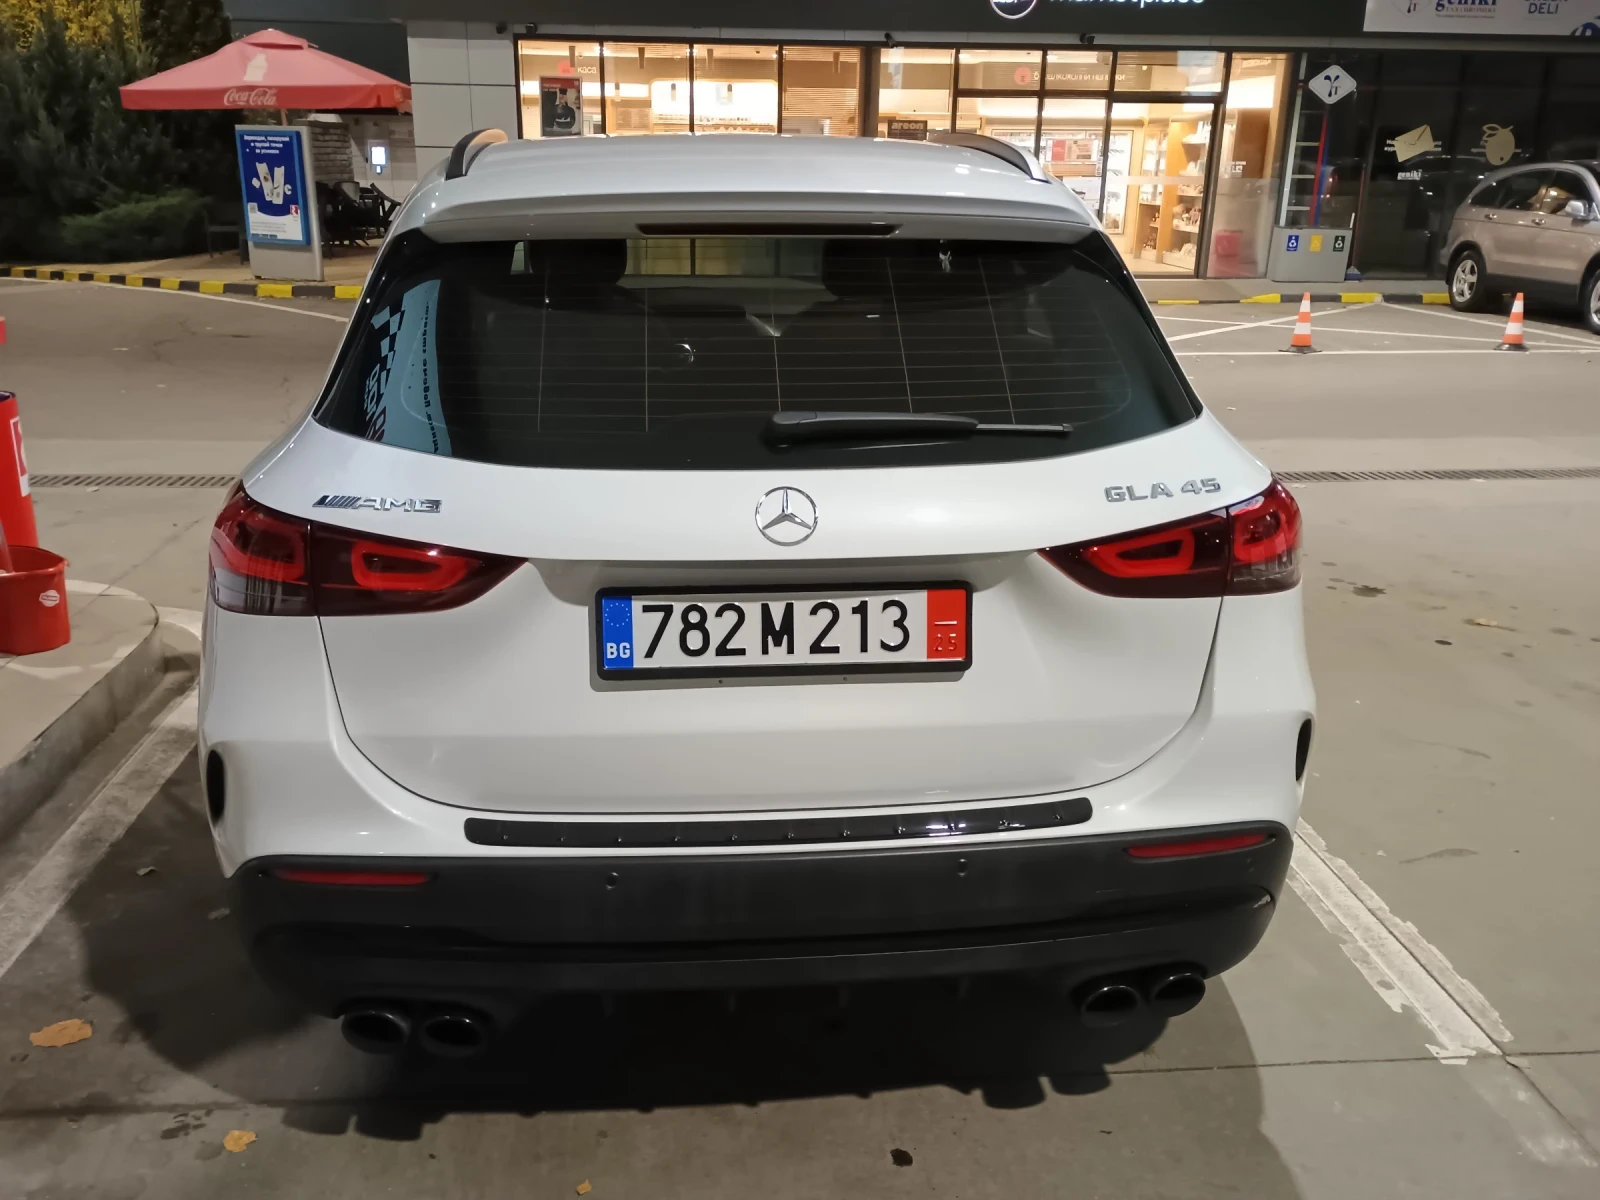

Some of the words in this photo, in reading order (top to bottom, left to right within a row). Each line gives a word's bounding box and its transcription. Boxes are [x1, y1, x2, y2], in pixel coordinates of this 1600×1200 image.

[1527, 3, 1559, 15] DELI
[577, 66, 597, 74] каса
[223, 87, 279, 106] Coca-Cola
[891, 122, 924, 130] areon
[1104, 482, 1174, 502] GLA
[1180, 478, 1221, 495] 45
[354, 496, 442, 513] AMG
[642, 603, 747, 658] 782
[760, 602, 795, 655] M
[809, 599, 910, 654] 213
[606, 642, 631, 659] BG
[933, 633, 957, 651] 25
